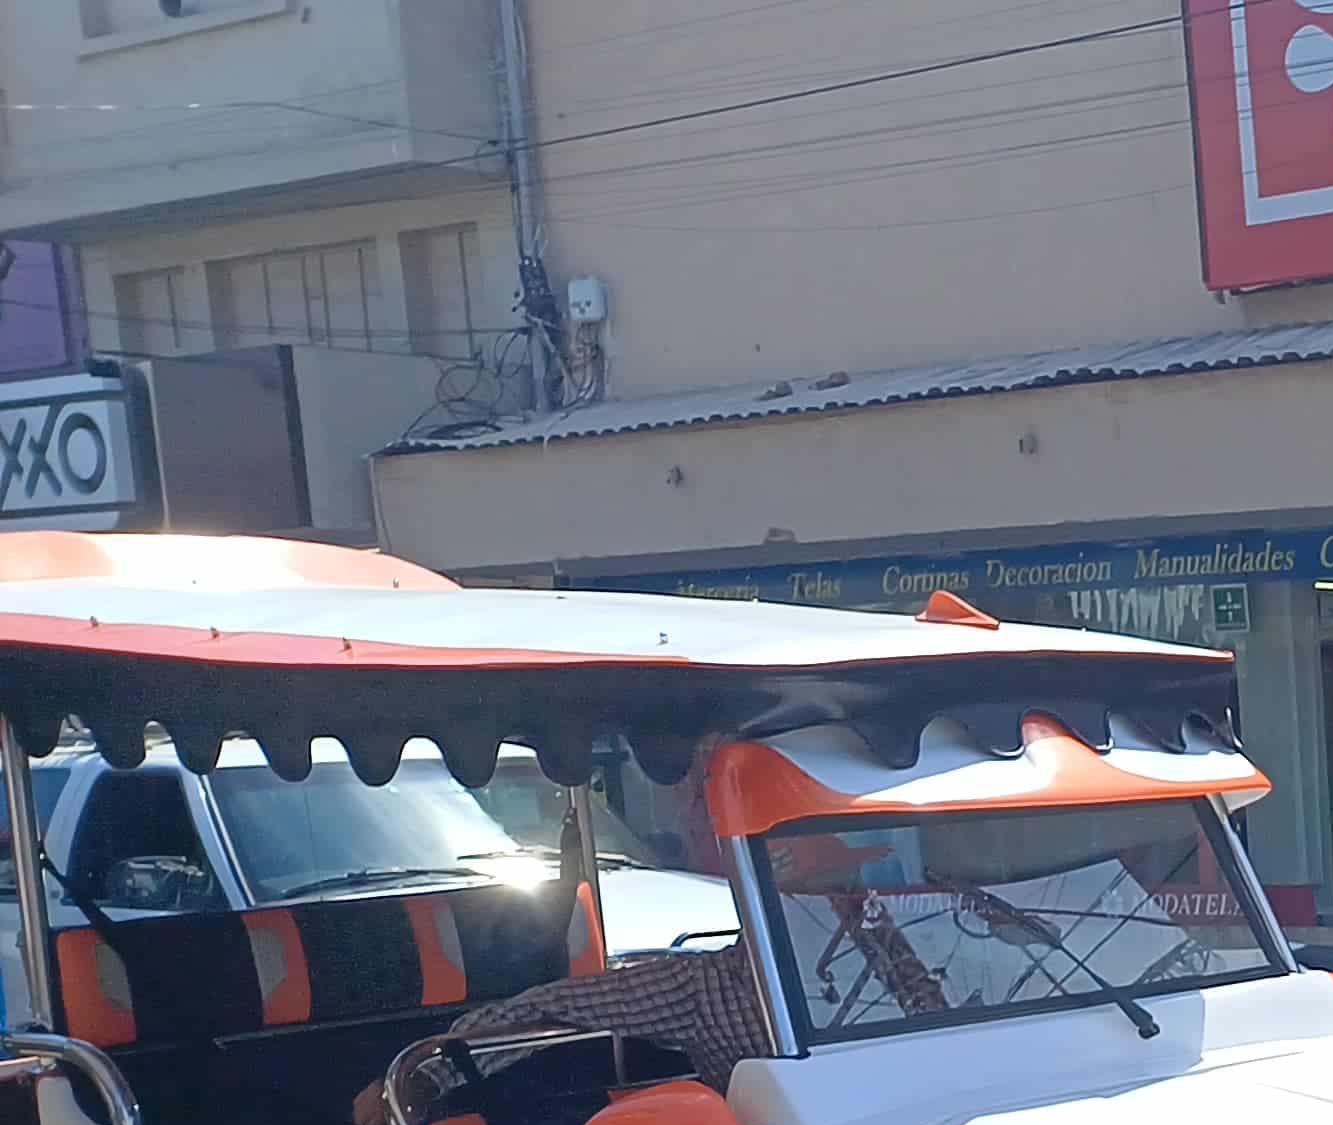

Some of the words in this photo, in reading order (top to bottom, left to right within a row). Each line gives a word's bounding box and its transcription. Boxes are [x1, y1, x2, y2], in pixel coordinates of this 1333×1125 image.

[788, 570, 841, 600] Telas
[882, 564, 968, 596] Cortinas
[1134, 541, 1296, 579] Manualidades
